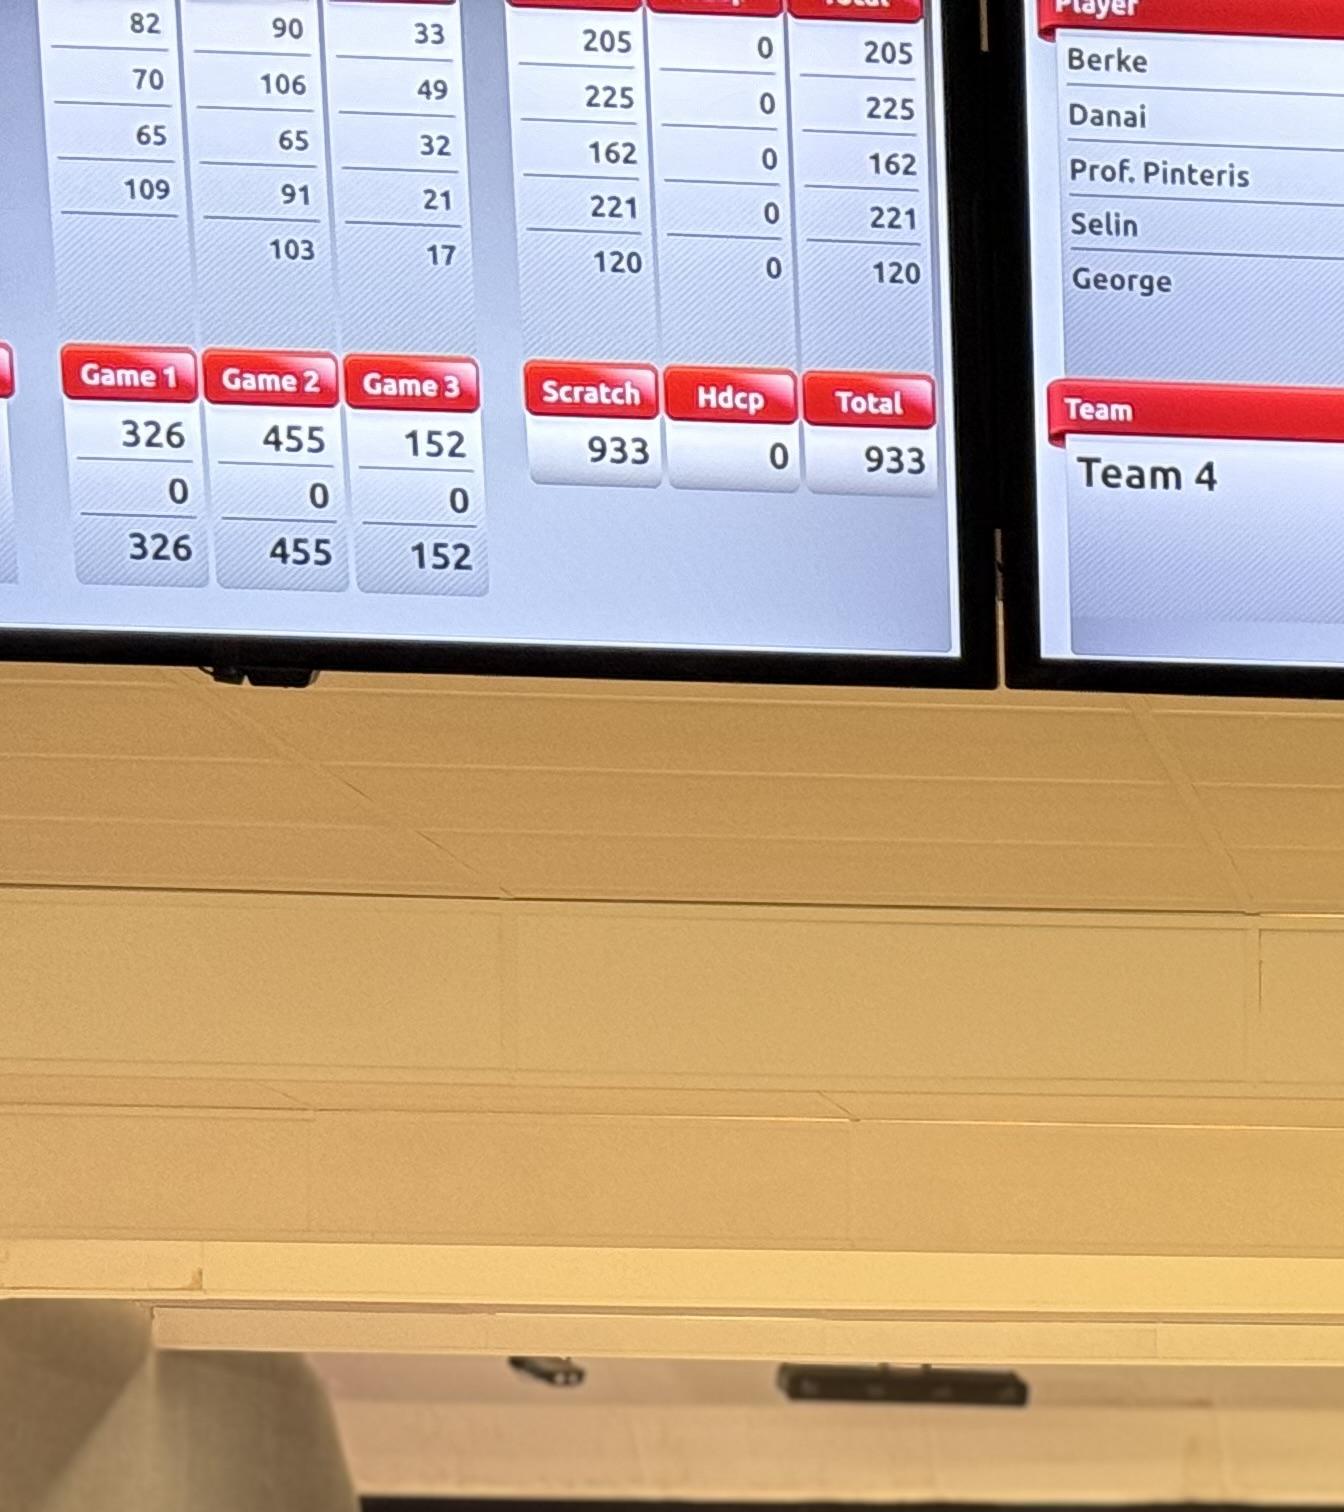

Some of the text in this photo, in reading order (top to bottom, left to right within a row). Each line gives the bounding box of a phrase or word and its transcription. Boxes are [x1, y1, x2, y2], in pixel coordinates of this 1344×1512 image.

[1055, 0, 1139, 19] Player
[131, 13, 160, 34] 82
[273, 18, 303, 39] 90
[415, 23, 444, 44] 33
[583, 29, 631, 53] 205
[758, 37, 773, 59] 0
[865, 41, 912, 64] 205
[1069, 48, 1147, 72] Berke
[133, 69, 163, 90] 70
[261, 74, 306, 95] 106
[418, 80, 447, 100] 49
[586, 85, 633, 109] 225
[760, 93, 775, 114] 0
[867, 97, 914, 120] 225
[1070, 104, 1145, 128] Danai
[137, 125, 166, 146] 65
[279, 130, 308, 151] 65
[421, 135, 451, 156] 32
[590, 142, 637, 164] 162
[762, 148, 777, 170] 0
[870, 153, 916, 175] 162
[1071, 159, 1249, 187] Prof. Pinteris
[125, 179, 170, 200] 109
[282, 184, 309, 205] 91
[424, 189, 450, 210] 21
[591, 195, 636, 218] 221
[765, 202, 779, 224] 0
[871, 207, 915, 229] 221
[1072, 212, 1137, 236] Selin
[270, 239, 314, 260] 103
[428, 245, 455, 265] 17
[594, 251, 641, 273] 120
[767, 257, 781, 279] 0
[874, 262, 920, 284] 120
[1073, 268, 1171, 296] George
[80, 364, 176, 388] Game 1
[222, 368, 320, 392] Game 2
[362, 374, 460, 397] Game 3
[542, 381, 640, 406] Scratch
[699, 387, 764, 415] Hdcp
[835, 391, 903, 415] Total
[1064, 397, 1133, 422] Team
[123, 420, 185, 448] 326
[263, 425, 324, 453] 455
[406, 430, 466, 457] 152
[589, 436, 649, 464] 933
[770, 443, 788, 469] 0
[865, 446, 925, 474] 933
[1077, 457, 1217, 491] Team 4
[169, 479, 188, 504] 0
[310, 483, 328, 508] 0
[450, 488, 468, 513] 0
[130, 533, 192, 561] 326
[270, 538, 331, 565] 455
[412, 543, 472, 570] 152
